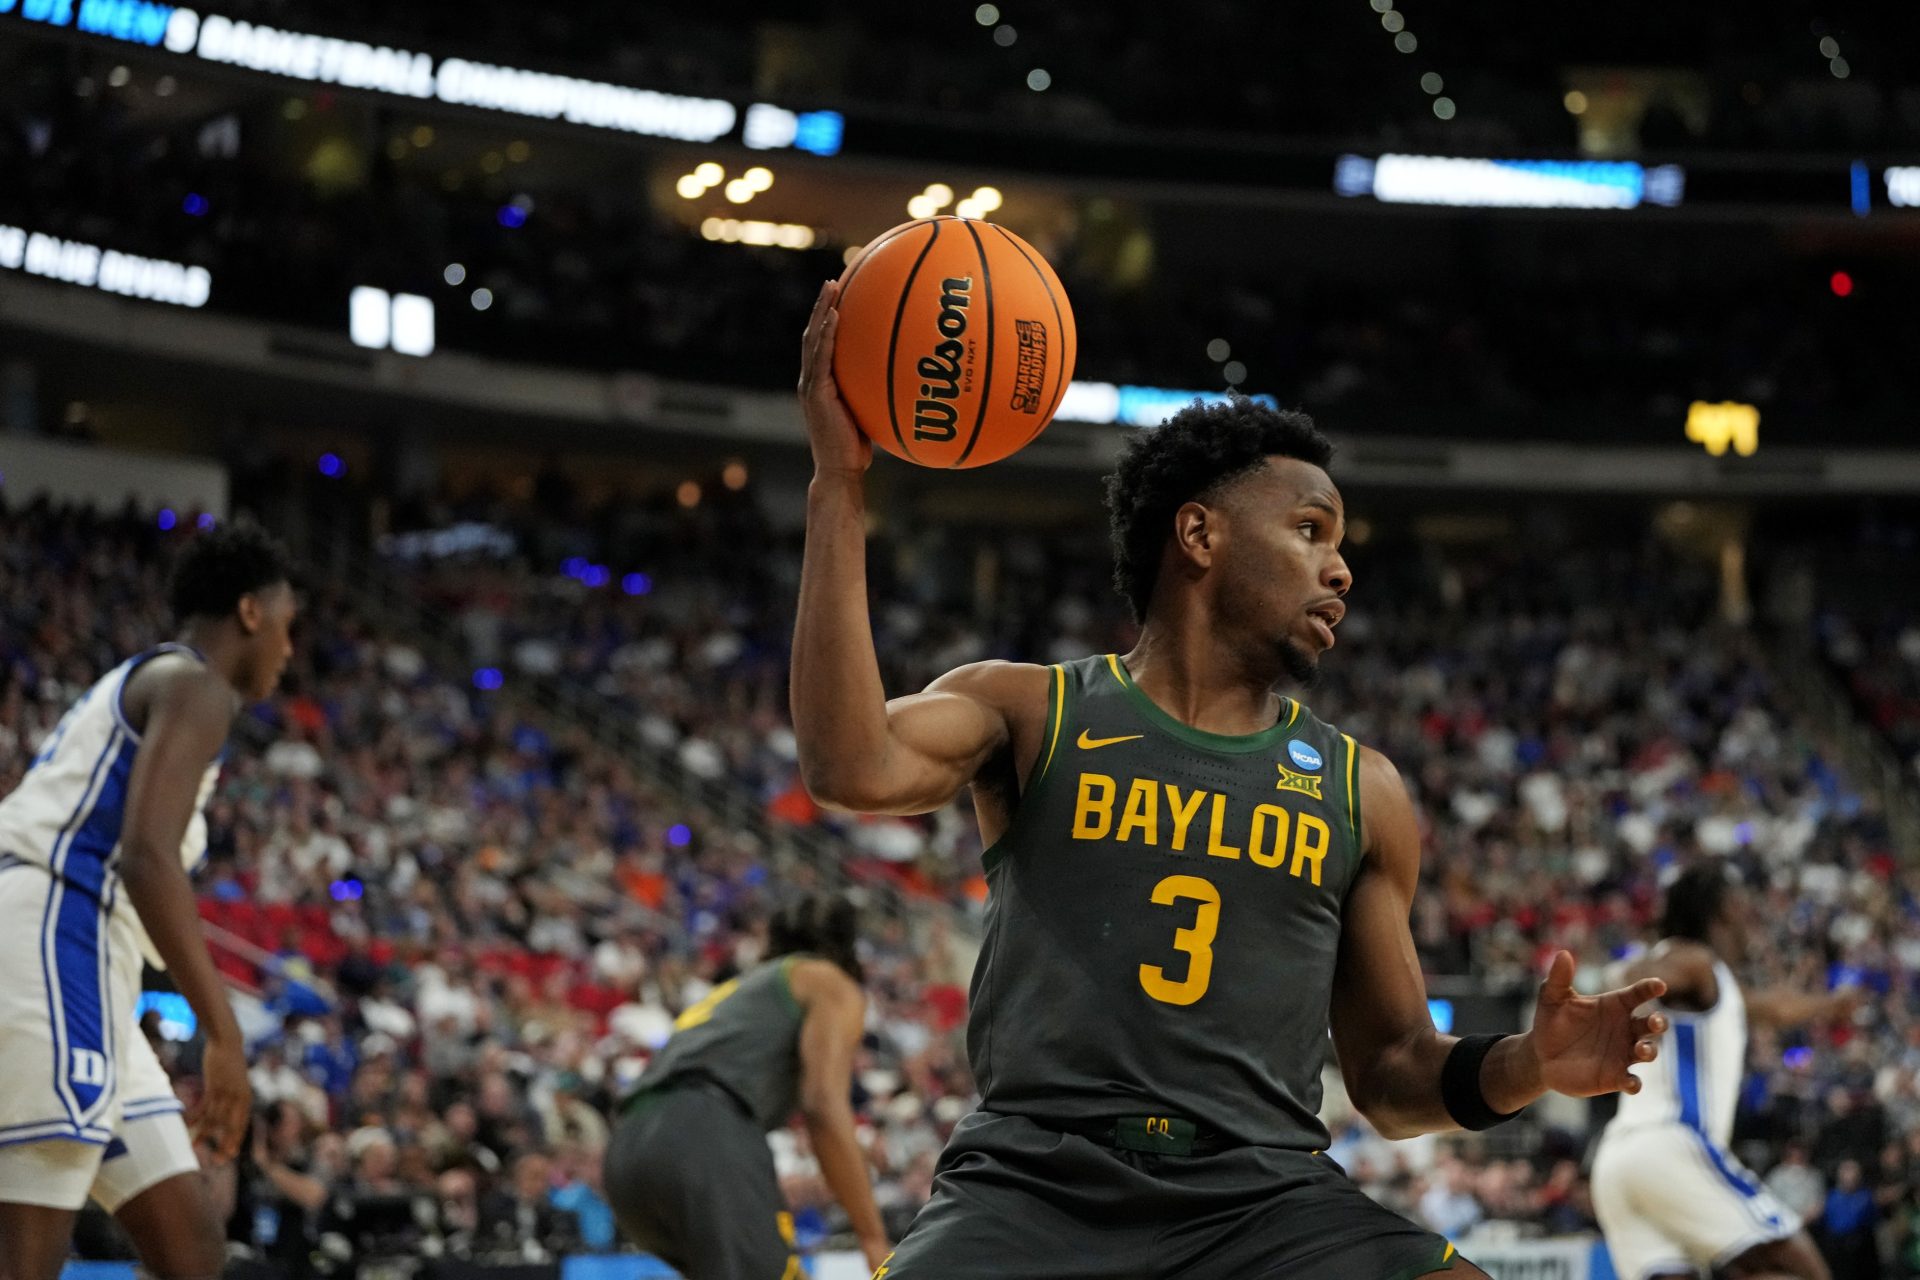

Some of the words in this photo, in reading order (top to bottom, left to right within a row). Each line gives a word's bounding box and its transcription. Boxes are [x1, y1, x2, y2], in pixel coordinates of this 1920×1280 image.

[913, 277, 972, 443] Wilson
[964, 368, 974, 393] EVO
[967, 339, 976, 365] NXT
[1015, 345, 1032, 398] MARCH
[1028, 321, 1047, 394] MADNESS
[1292, 751, 1322, 766] NCAA
[1072, 773, 1330, 887] BAYLOR
[1139, 875, 1221, 1006] 3
